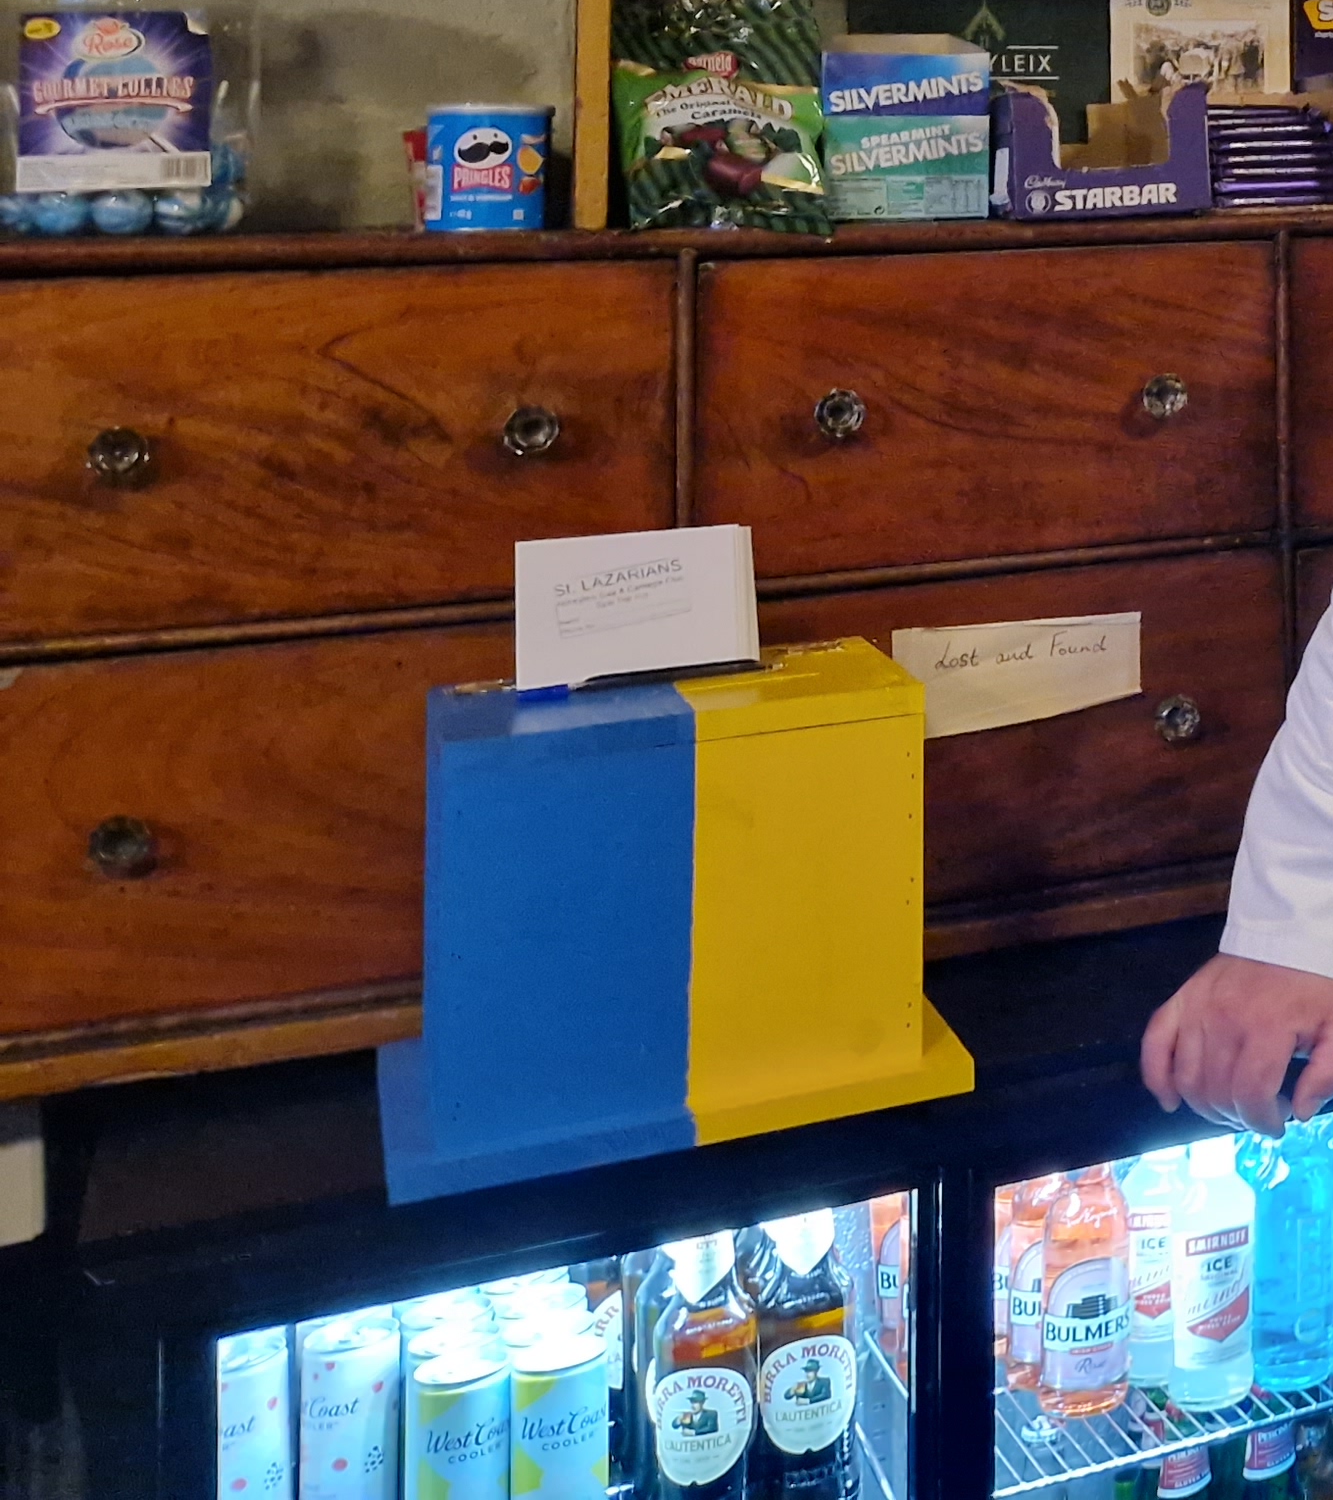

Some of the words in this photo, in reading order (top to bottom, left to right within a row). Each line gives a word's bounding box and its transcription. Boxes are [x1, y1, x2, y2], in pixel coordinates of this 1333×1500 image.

[33, 78, 108, 103] GOURMET
[117, 75, 194, 99] LOLLIES
[644, 77, 794, 122] EMERALD
[829, 71, 984, 114] SILVERMINTS
[860, 123, 951, 149] SPEARMINT
[829, 131, 985, 176] SILVERMINTS
[453, 165, 511, 190] PRINGLES
[1054, 182, 1177, 212] STARBAR
[580, 558, 683, 592] LAZARIANS
[934, 640, 979, 671] Lost
[995, 643, 1034, 665] and
[1049, 629, 1107, 657] Found
[1140, 1236, 1167, 1250] ICE
[1187, 1228, 1248, 1255] SMIRNOFF
[1205, 1254, 1233, 1272] ICE
[1045, 1312, 1131, 1344] BULMERS
[763, 1351, 798, 1405] BIRRA
[801, 1343, 854, 1391] MORETTI
[687, 1375, 748, 1425] MORETTI
[426, 1429, 472, 1455] West
[521, 1416, 567, 1441] West
[541, 1429, 595, 1452] COOLER
